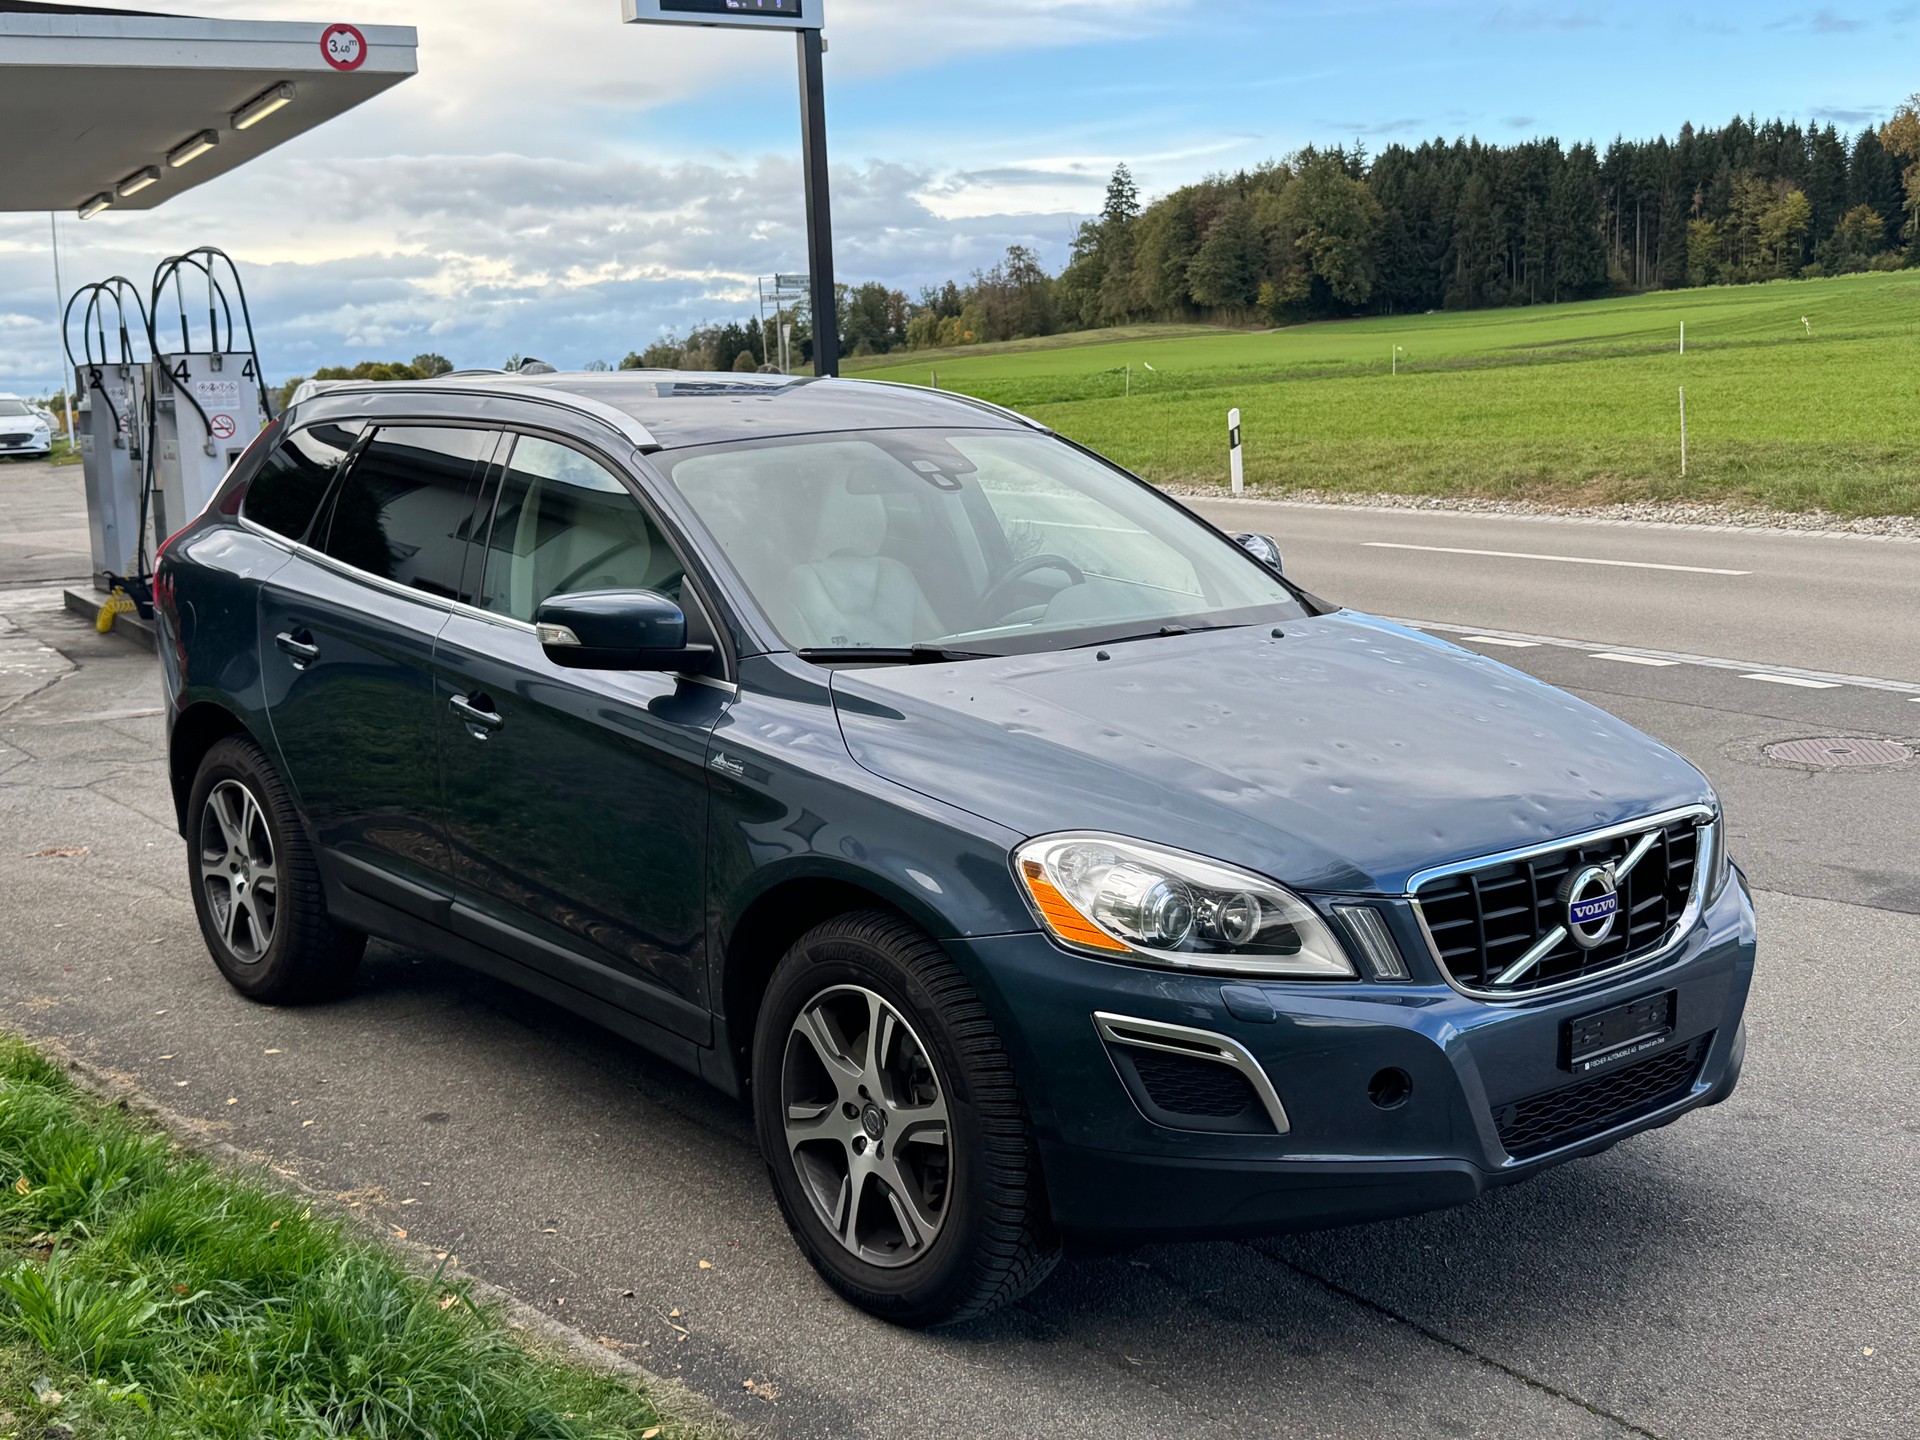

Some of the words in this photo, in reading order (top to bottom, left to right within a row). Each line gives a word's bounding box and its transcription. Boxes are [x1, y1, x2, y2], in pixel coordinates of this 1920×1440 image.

[173, 359, 191, 383] 4
[241, 358, 255, 382] 4
[1573, 898, 1616, 918] VOLVO
[817, 942, 899, 983] BRIDGESTONE
[1590, 1057, 1607, 1067] FISCHER
[1607, 1048, 1631, 1061] AUTOMOBILE
